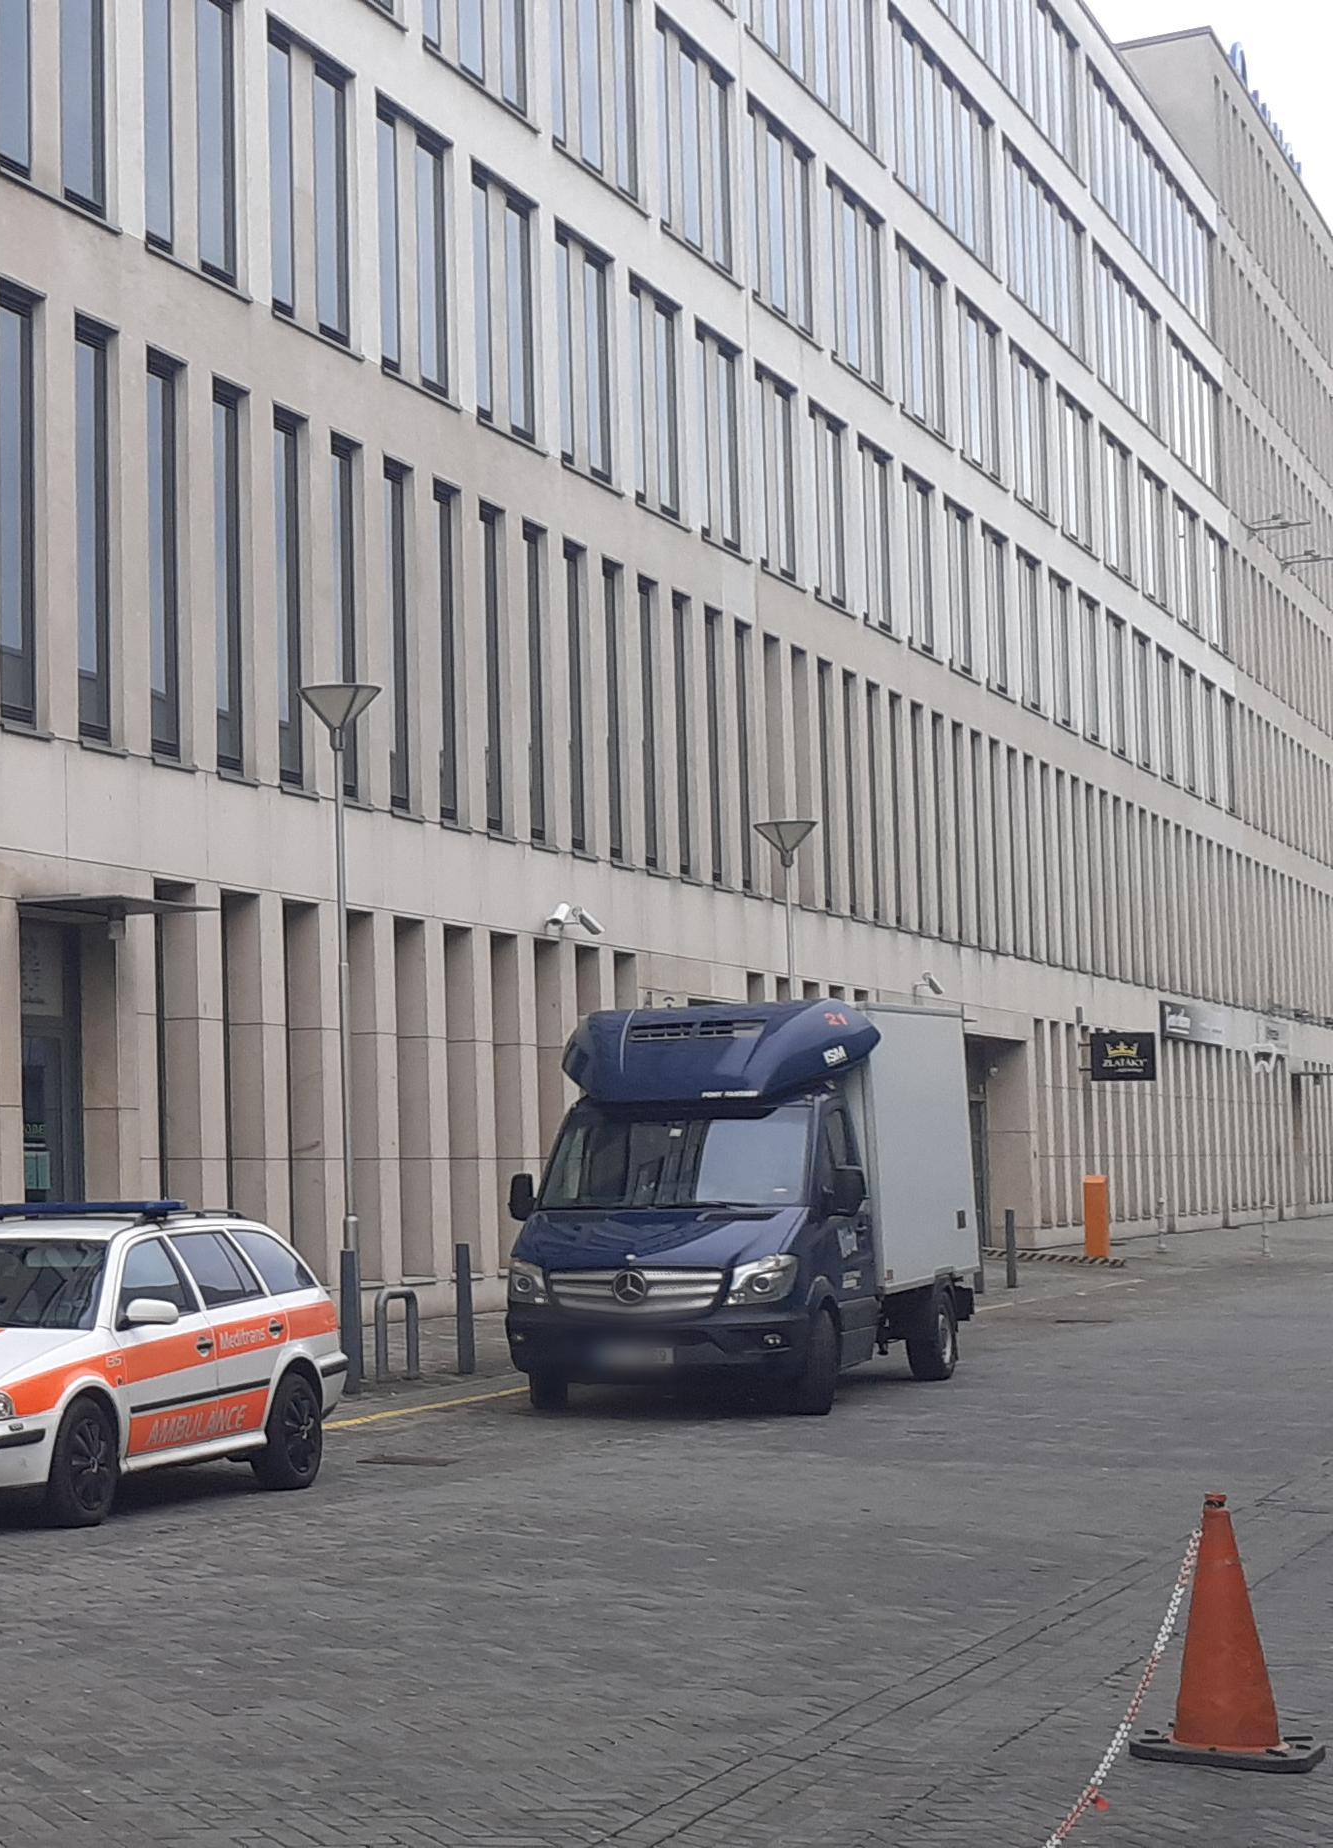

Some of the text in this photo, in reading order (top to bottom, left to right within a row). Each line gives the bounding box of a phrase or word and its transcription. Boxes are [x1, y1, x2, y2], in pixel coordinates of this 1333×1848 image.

[824, 1012, 849, 1025] 21
[219, 1328, 266, 1350] Meditrans
[145, 1404, 247, 1446] AMBULANCE
